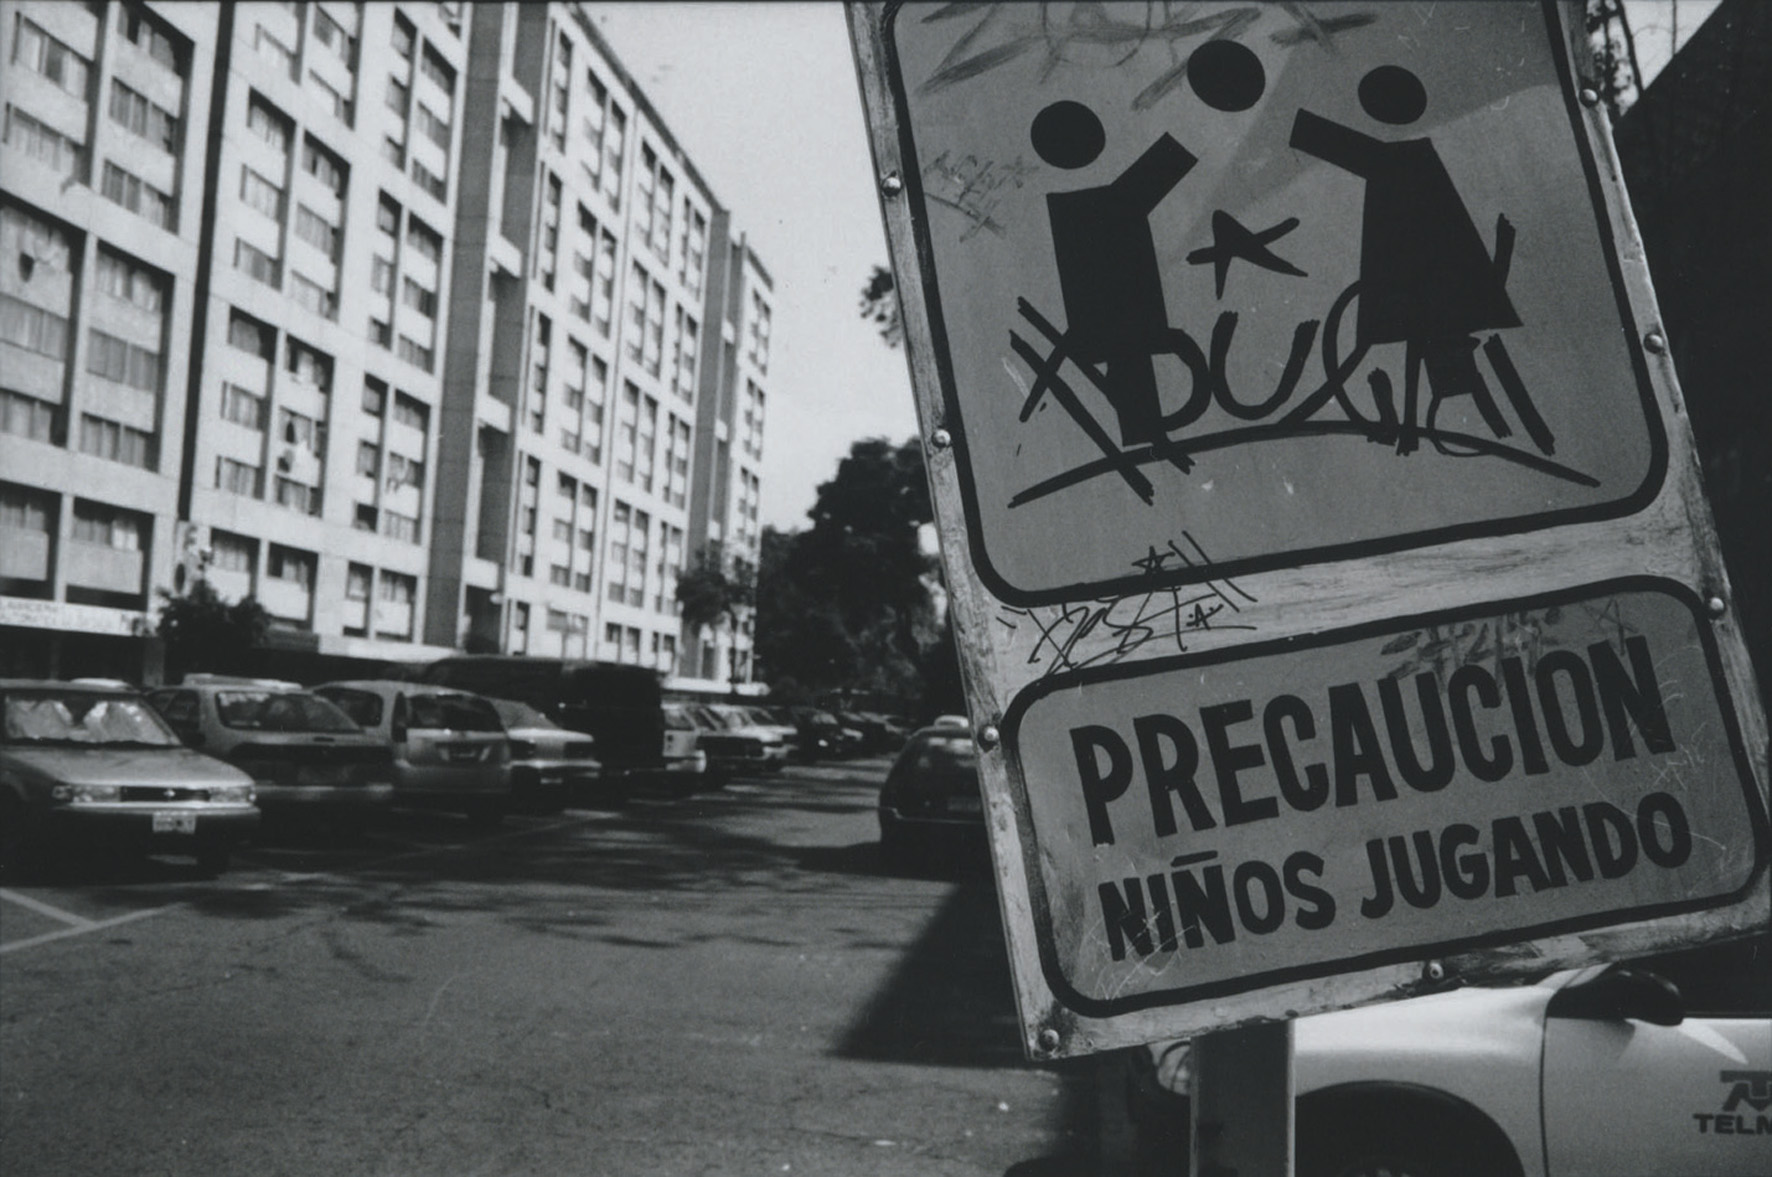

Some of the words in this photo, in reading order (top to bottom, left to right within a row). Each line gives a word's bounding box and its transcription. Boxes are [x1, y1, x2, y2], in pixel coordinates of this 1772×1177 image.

[1069, 634, 1677, 848] PRECAUCION
[1098, 851, 1337, 962] NIÑOS
[1360, 791, 1692, 920] JUGANDO
